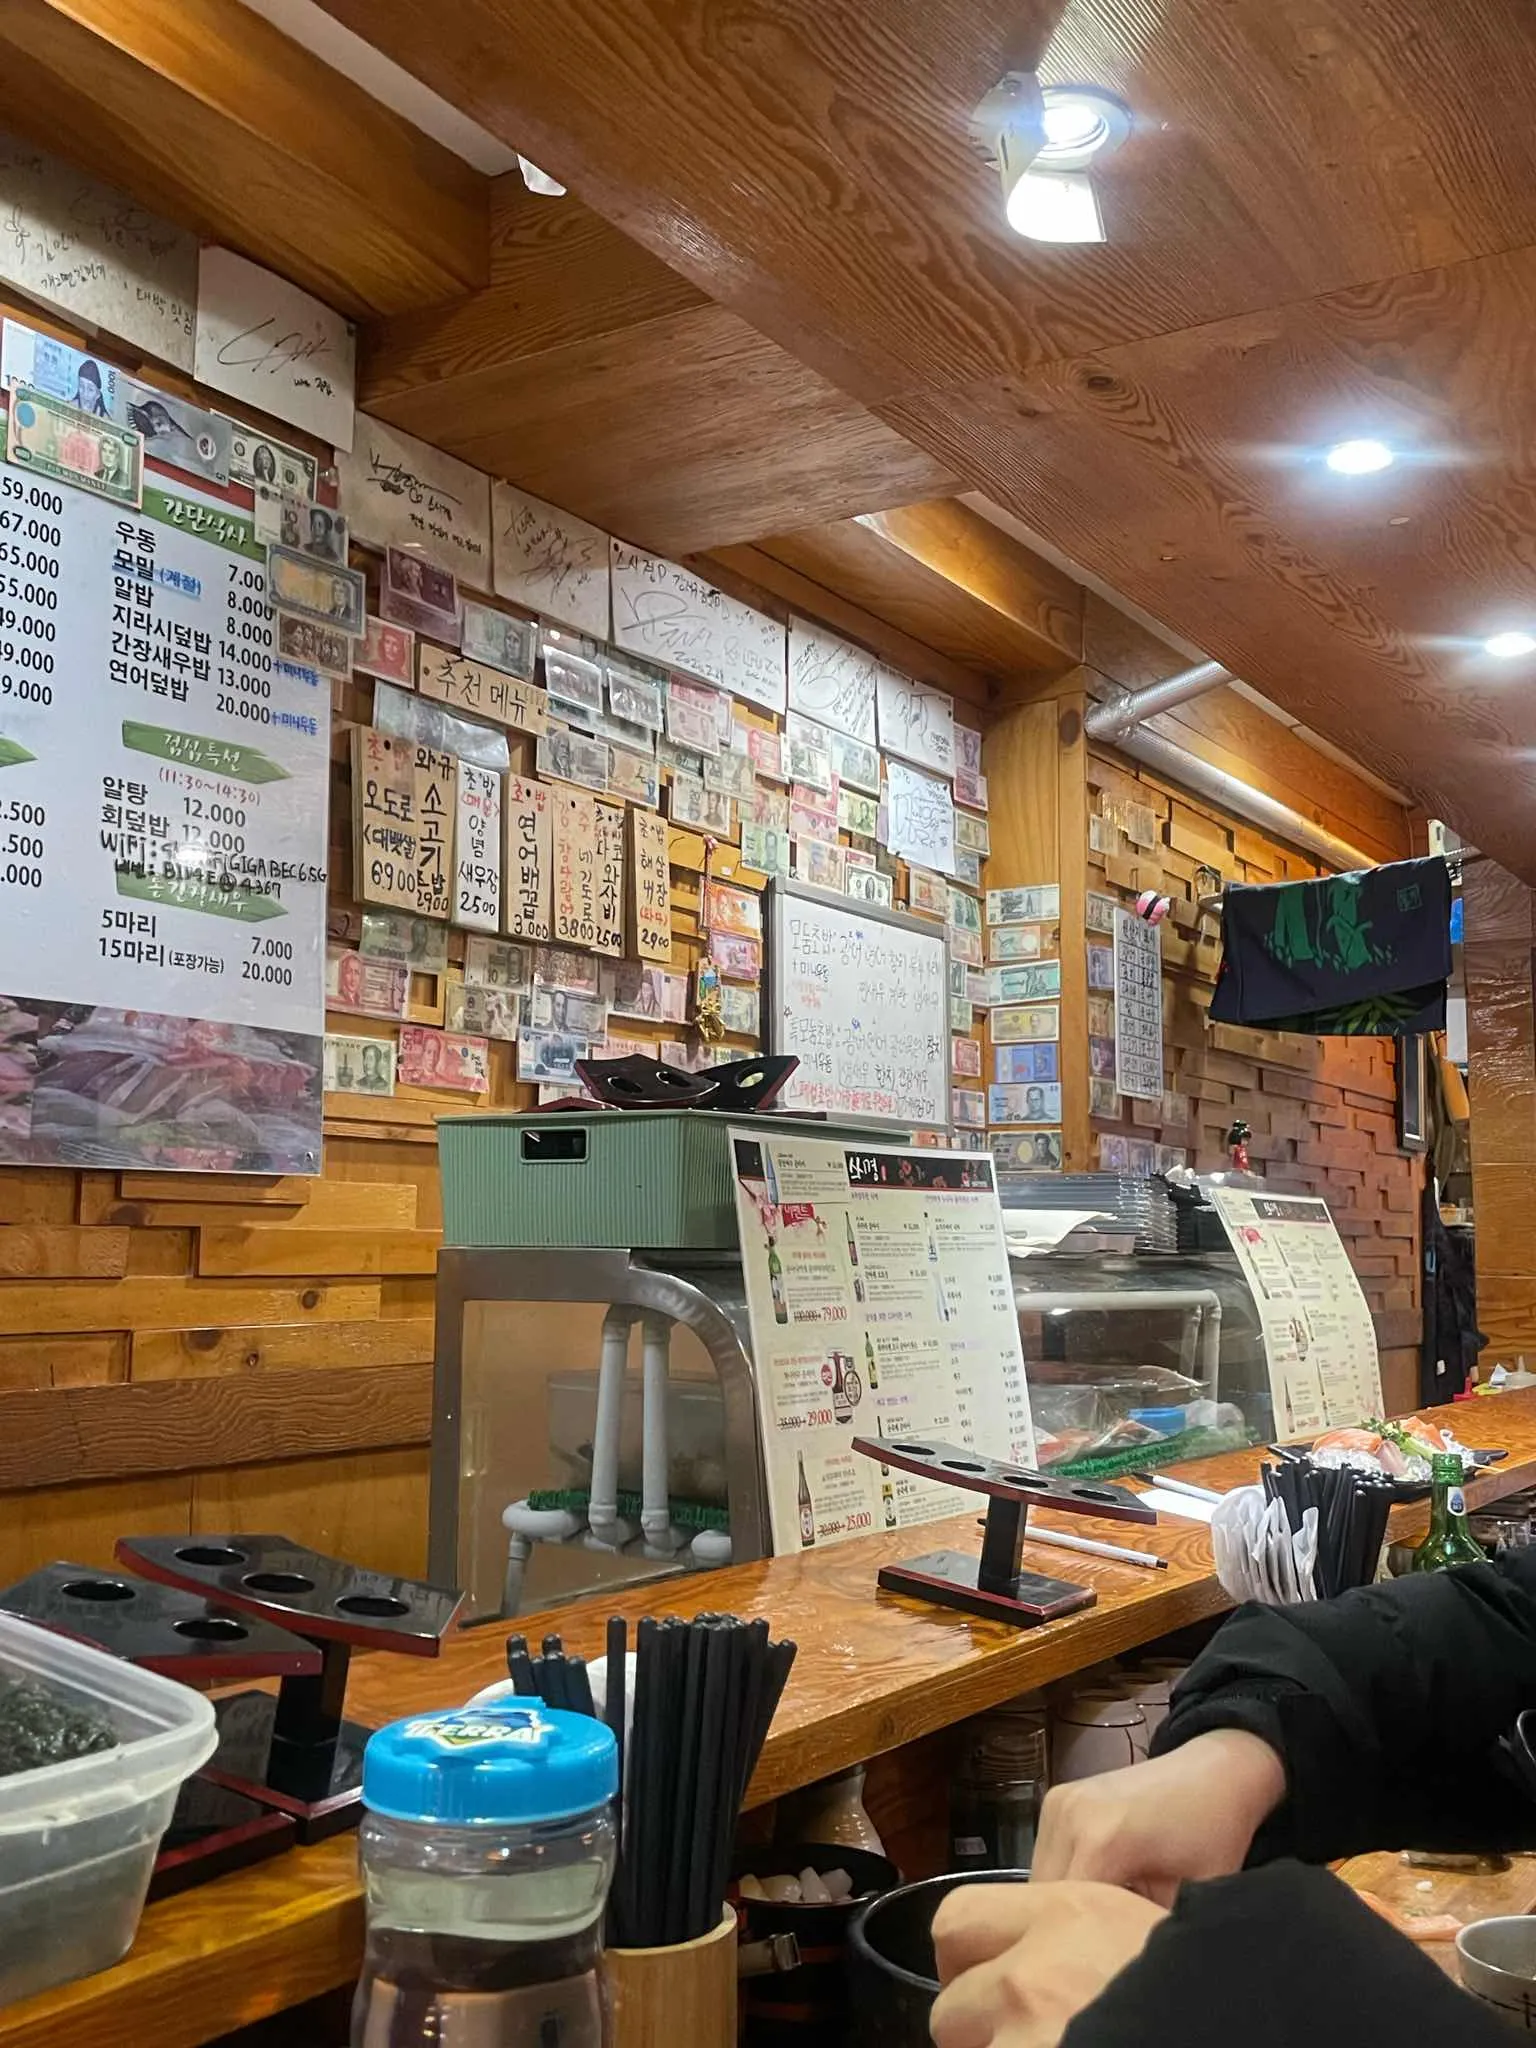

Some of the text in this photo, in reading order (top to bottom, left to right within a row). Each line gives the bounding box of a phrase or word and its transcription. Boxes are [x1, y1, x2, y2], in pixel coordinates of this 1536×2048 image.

[2, 476, 63, 515] 59.000
[0, 511, 61, 546] 67.000
[115, 521, 157, 554] 우동
[163, 496, 249, 547] 간단식사
[0, 542, 59, 578] 65.000
[113, 549, 156, 581] 모밀
[228, 564, 264, 593] 7.00
[114, 576, 154, 608] 알밥
[228, 590, 274, 621] 8.000
[112, 605, 272, 673] 지라시덮밥 14.000
[226, 617, 273, 647] 8.000
[0, 642, 54, 673] 9.000
[111, 631, 271, 698] 간장새우밥 13.000
[109, 659, 271, 725] 연어덮밥 20.000
[437, 655, 528, 725] 추천 메뉴
[414, 747, 456, 780] 와규
[0, 801, 45, 827] .500
[102, 775, 246, 828] 알탕 12.000
[364, 779, 415, 822] 오도로
[101, 803, 245, 854] 회덮밥 12.000
[420, 783, 448, 878] 소고기
[458, 860, 498, 895] 새우장
[599, 862, 621, 924] 와사비
[102, 909, 293, 960] 5마리 7.000
[99, 936, 293, 986] 15마리 (포장가능) 20.000
